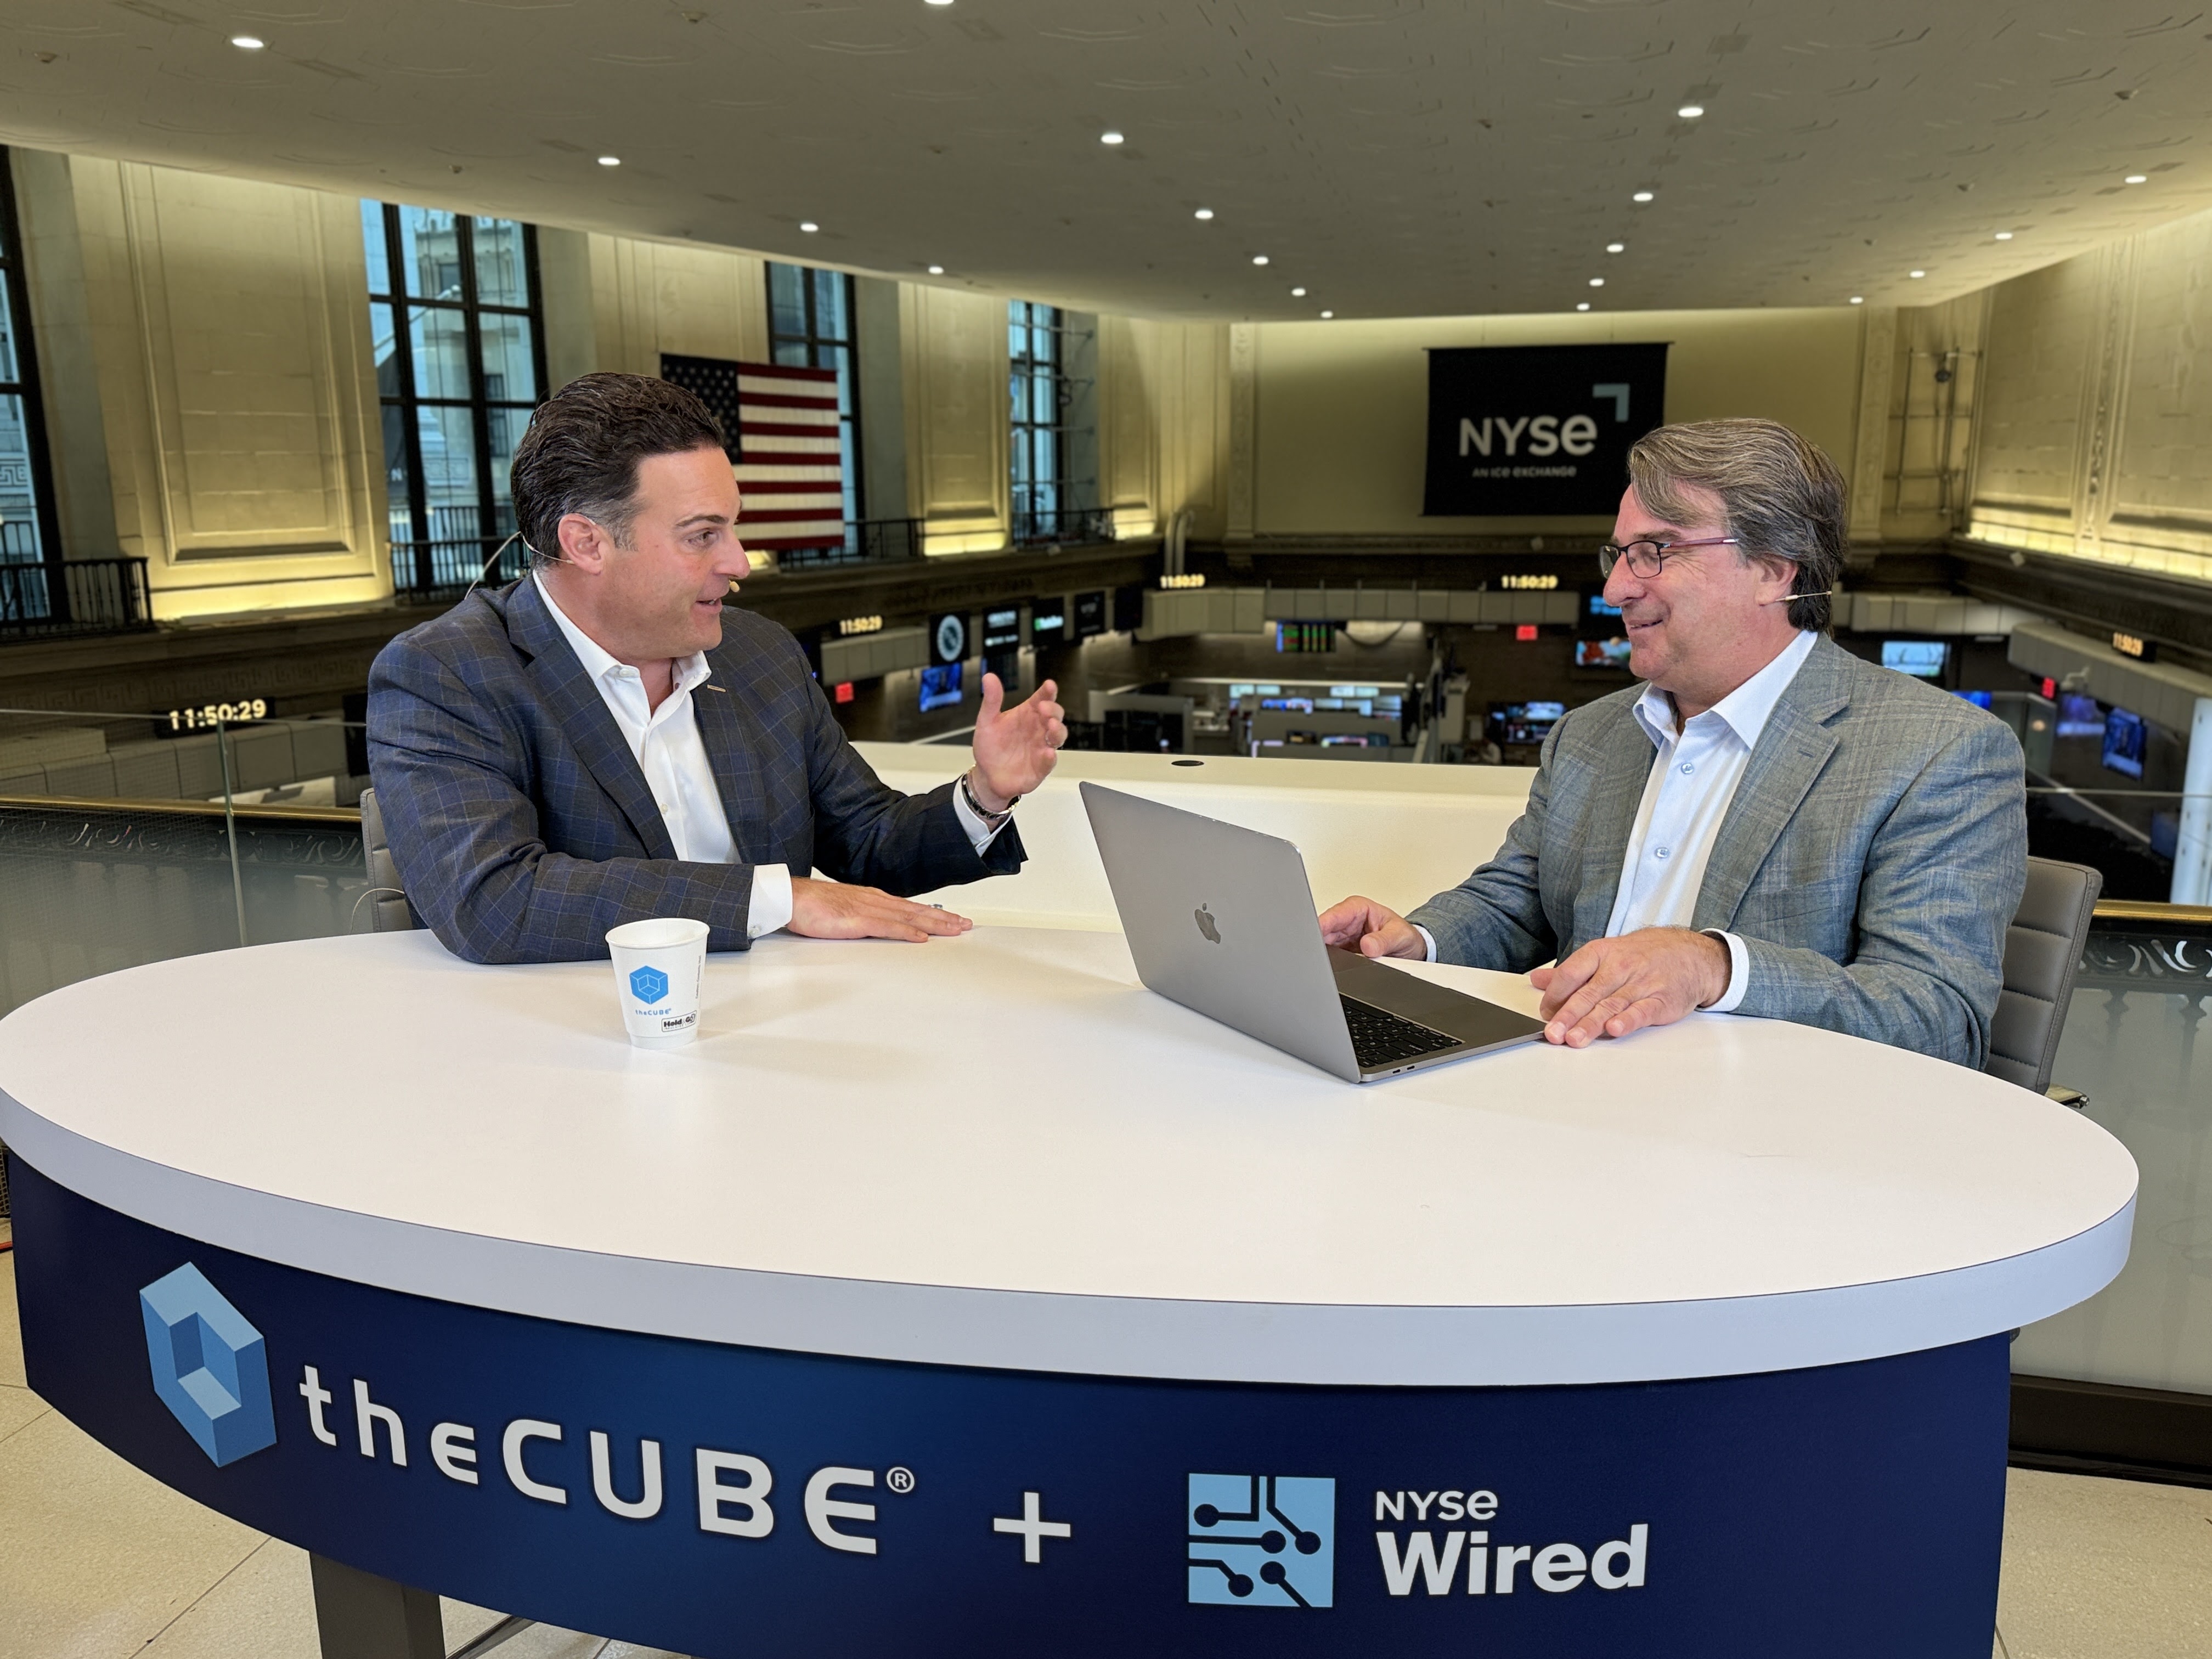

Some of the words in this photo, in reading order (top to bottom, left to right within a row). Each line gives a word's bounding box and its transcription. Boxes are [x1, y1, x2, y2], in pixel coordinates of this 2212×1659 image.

[1472, 467, 1489, 477] AN
[1502, 575, 1558, 589] 11:50:29
[840, 615, 882, 634] 11:50:29
[170, 699, 267, 730] 11:50:29
[664, 1019, 682, 1027] Hold
[1376, 1523, 1648, 1595] Wired
